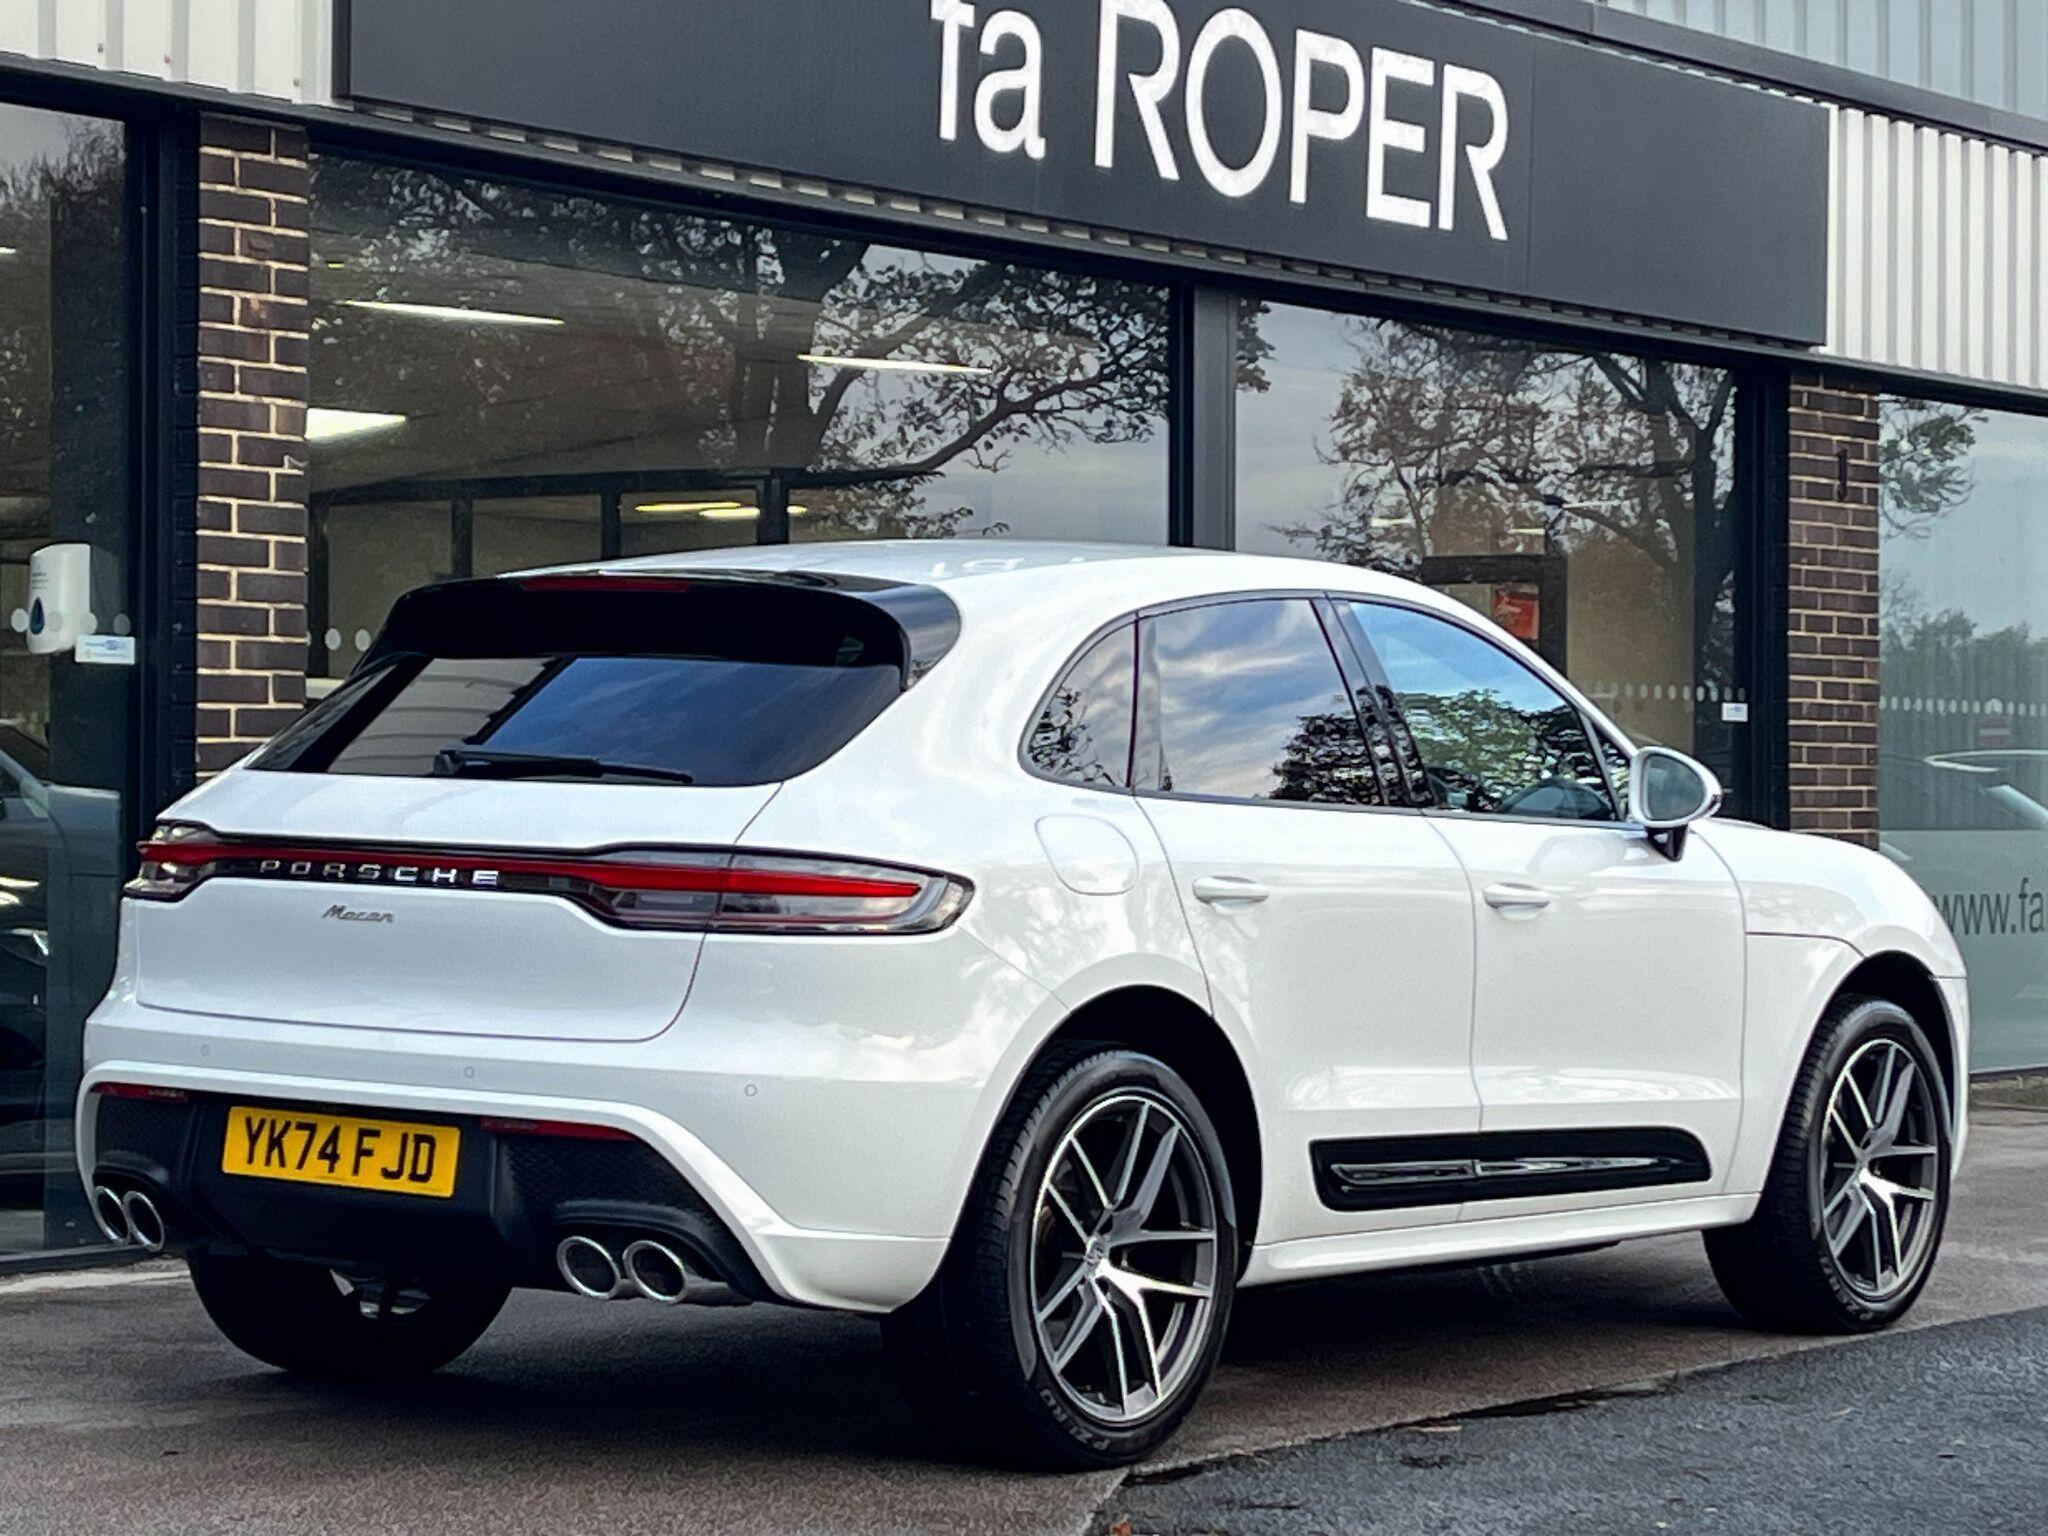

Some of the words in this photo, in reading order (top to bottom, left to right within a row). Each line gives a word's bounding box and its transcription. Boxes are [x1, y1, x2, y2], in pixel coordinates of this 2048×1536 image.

[930, 0, 1046, 159] fa
[1094, 0, 1508, 241] ROPER
[259, 859, 499, 886] PORSCHE
[321, 904, 394, 923] Macan
[244, 1116, 341, 1174] YK74
[351, 1128, 437, 1183] FJD
